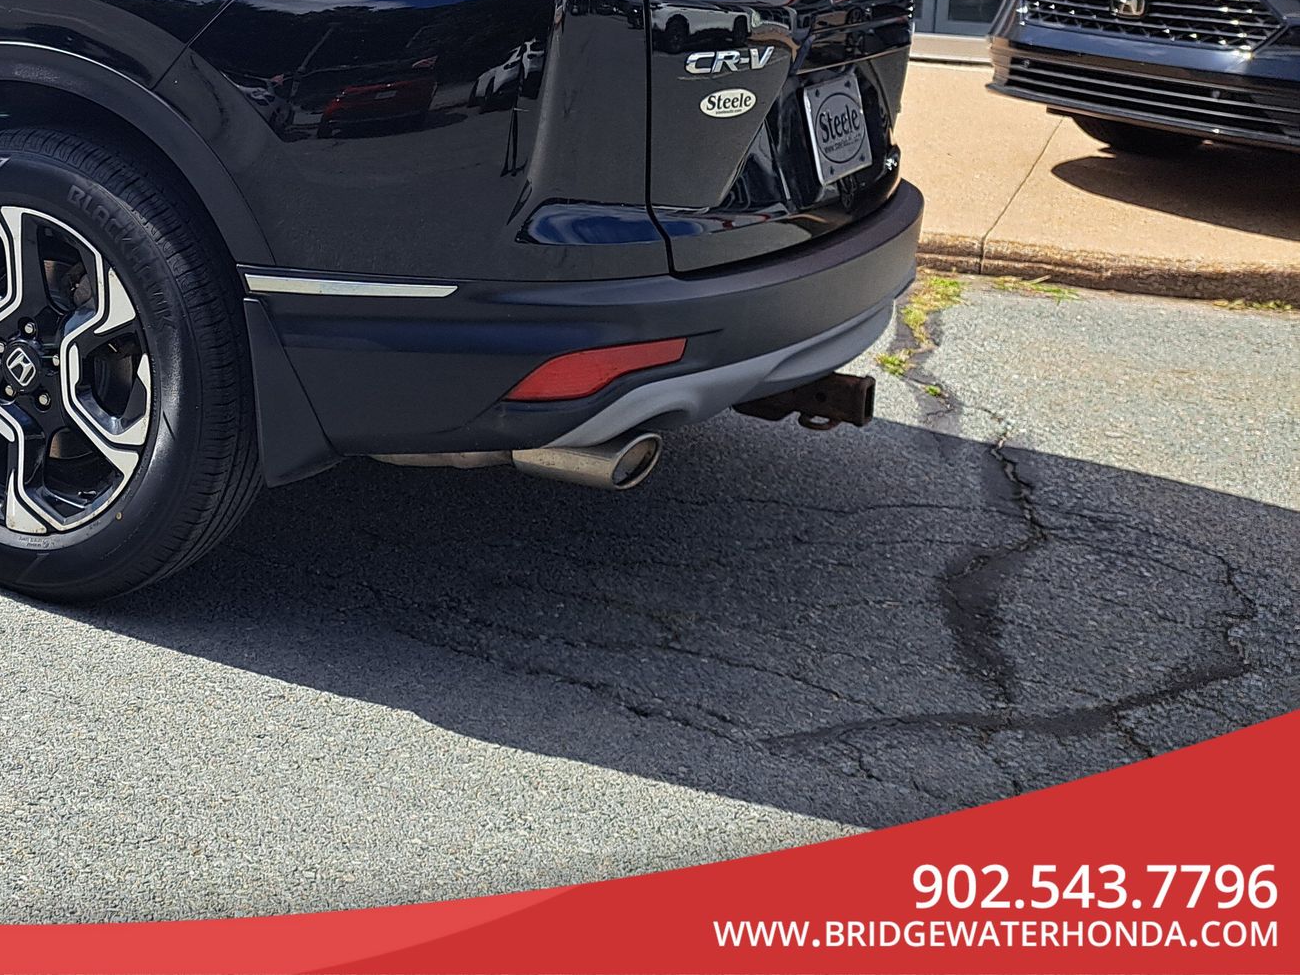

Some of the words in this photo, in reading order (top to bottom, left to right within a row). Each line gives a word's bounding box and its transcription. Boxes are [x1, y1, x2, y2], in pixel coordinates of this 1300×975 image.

[685, 46, 775, 74] CR-V
[706, 93, 752, 111] Steele
[819, 104, 860, 143] Steele
